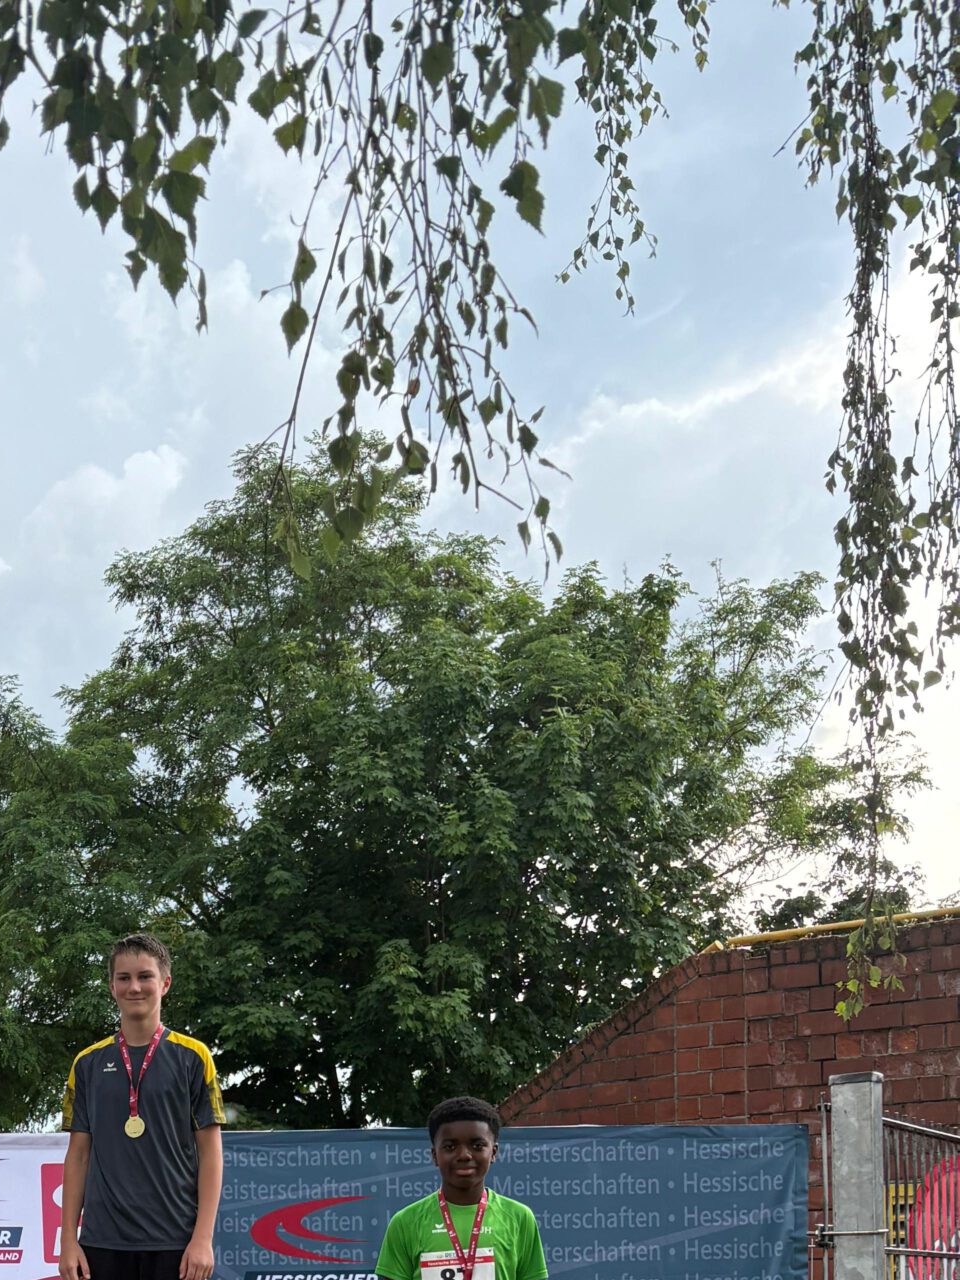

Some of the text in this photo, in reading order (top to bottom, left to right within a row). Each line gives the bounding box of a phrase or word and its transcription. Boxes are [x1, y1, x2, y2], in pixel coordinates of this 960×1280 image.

[223, 1144, 363, 1167] eisterschaften
[683, 1137, 784, 1160] Hessische
[222, 1177, 363, 1200] eisterschaften
[492, 1172, 660, 1197] Meisterschaften
[683, 1170, 784, 1193] Hessische
[537, 1206, 660, 1230] sterschaften
[684, 1203, 785, 1227] Hessische
[544, 1239, 661, 1263] terschaften
[684, 1237, 784, 1260] Hessische
